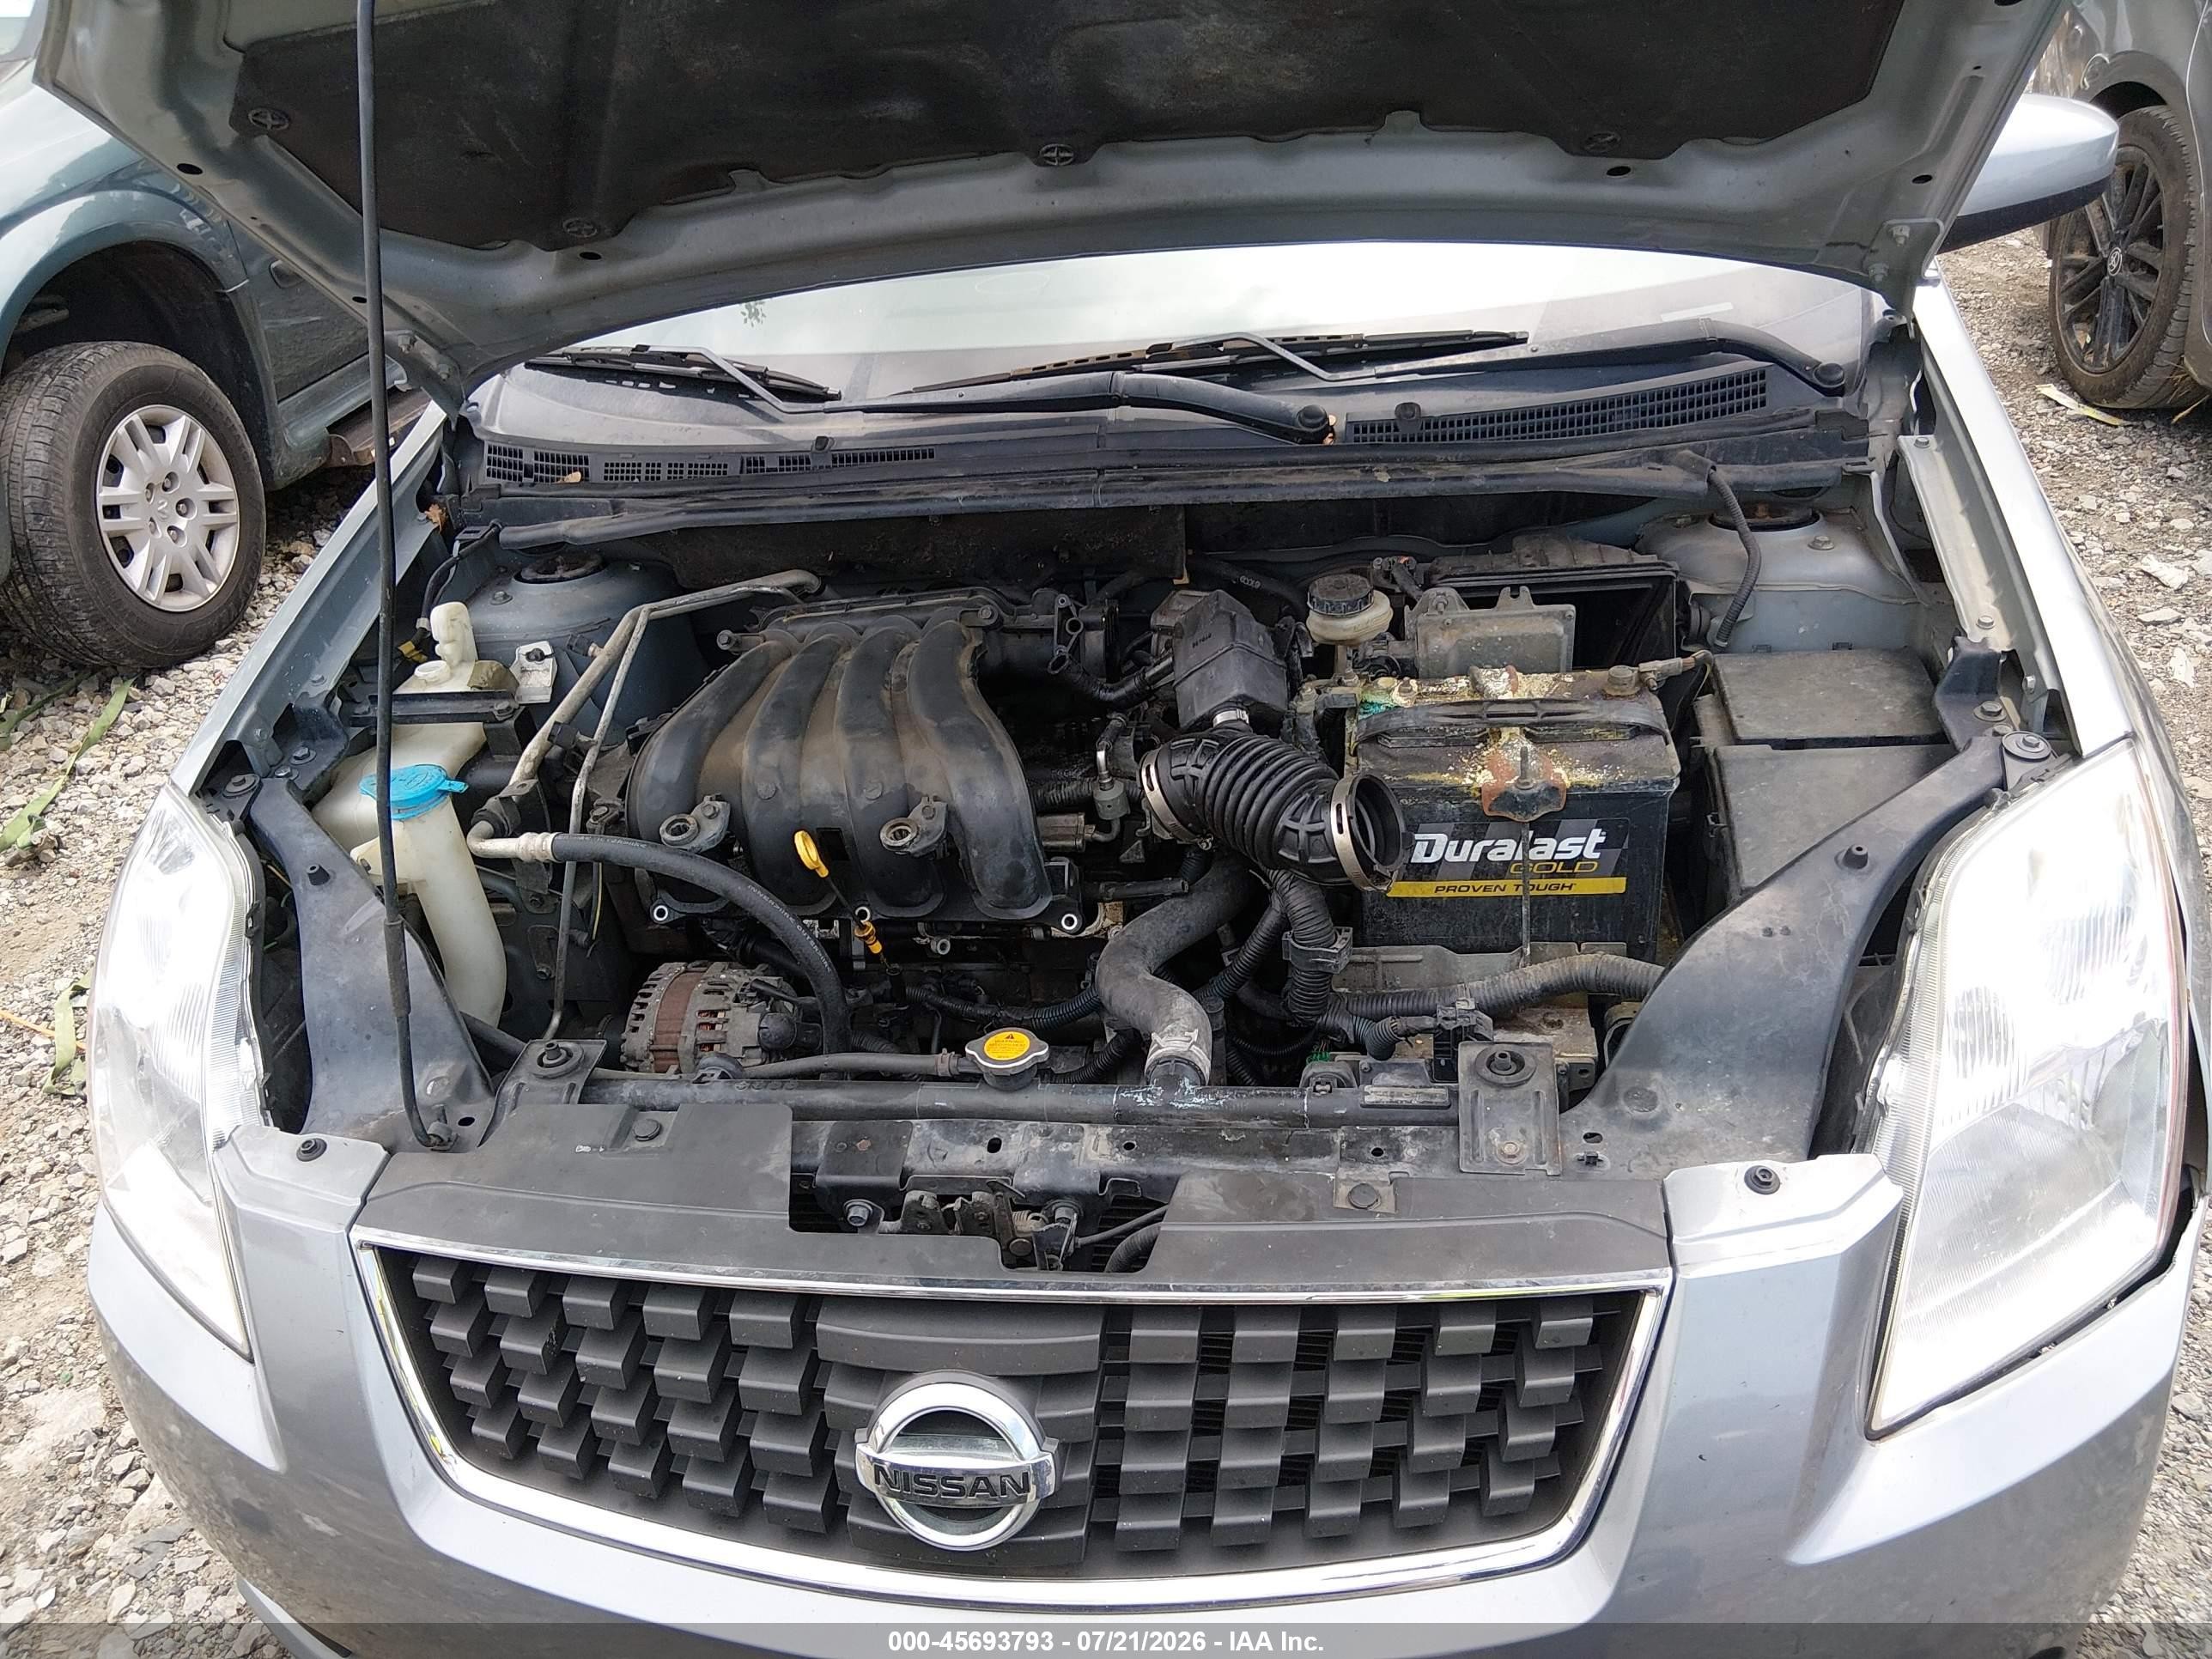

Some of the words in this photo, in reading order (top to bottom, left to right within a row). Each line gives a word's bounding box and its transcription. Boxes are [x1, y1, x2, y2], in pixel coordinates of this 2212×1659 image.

[1410, 828, 1606, 863] Duralast
[1510, 860, 1599, 874] GOLD
[1434, 884, 1506, 894] PROVEN
[872, 1463, 1031, 1498] NISSAN
